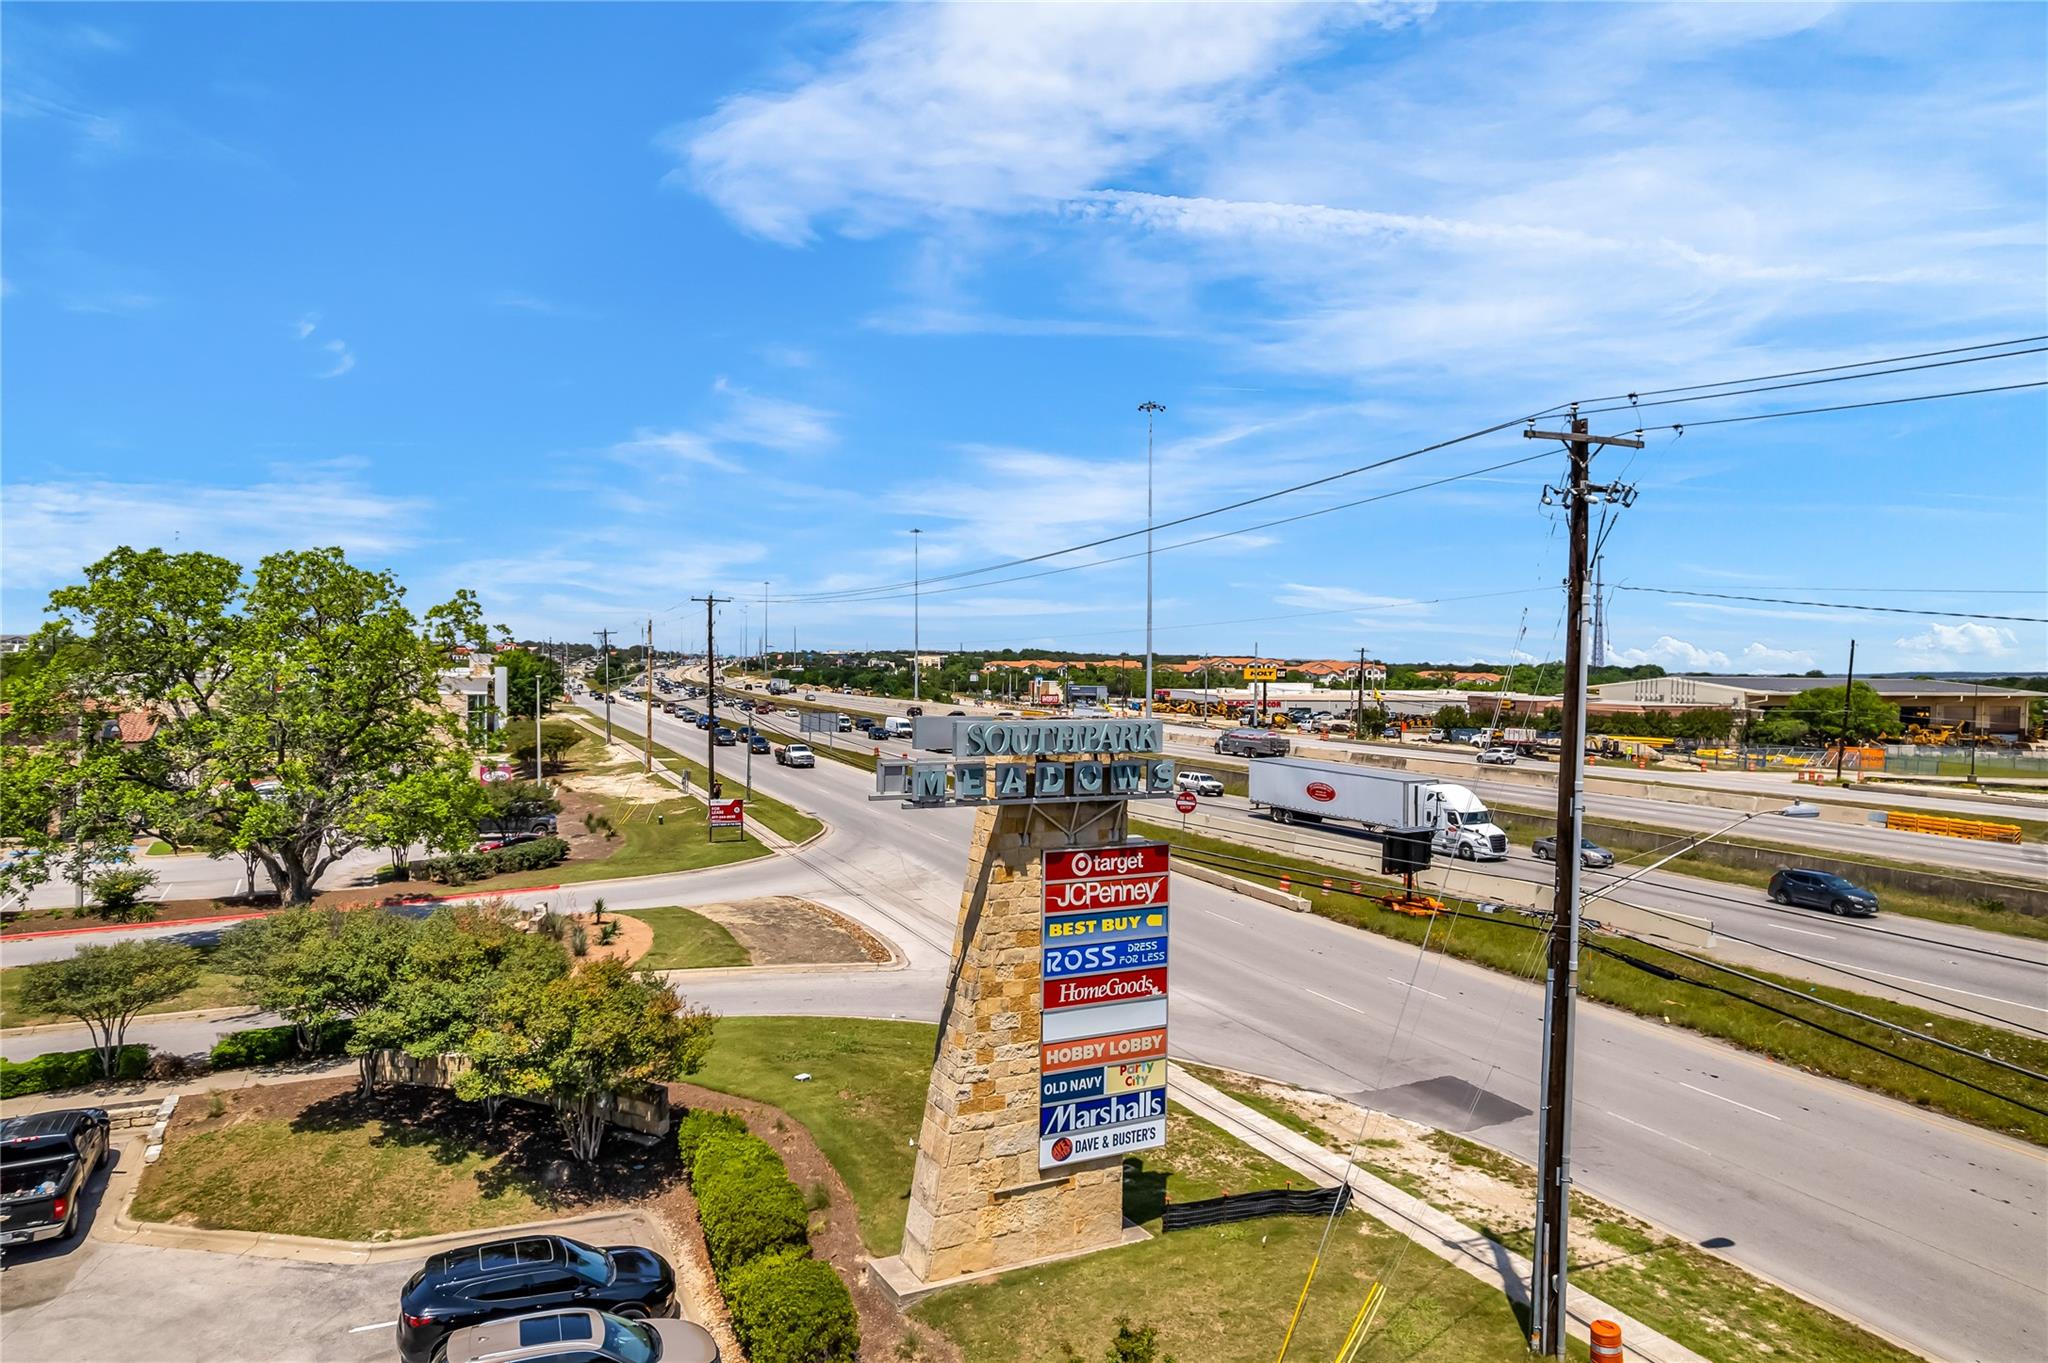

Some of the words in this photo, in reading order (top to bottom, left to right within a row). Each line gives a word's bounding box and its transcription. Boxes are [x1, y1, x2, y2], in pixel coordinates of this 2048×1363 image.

[966, 721, 1161, 755] SOUTHPARK
[918, 759, 1174, 797] MEADOWS
[1094, 852, 1144, 873] target
[1047, 876, 1166, 908] JCPenney
[1049, 921, 1097, 937] BEST
[1101, 915, 1142, 932] BUY
[1046, 945, 1116, 973] ROSS
[1119, 955, 1139, 965] FOR
[1141, 951, 1165, 963] LESS
[1127, 941, 1158, 953] DRESS
[1058, 975, 1154, 1003] HomeGoods
[1046, 1042, 1106, 1065] HOBBY
[1109, 1034, 1163, 1056] LOBBY
[1044, 1081, 1068, 1096] OLD
[1070, 1075, 1103, 1092] NAVY
[1125, 1075, 1149, 1087] City
[1044, 1090, 1162, 1135] Marshalls
[1075, 1137, 1099, 1154] DAVE
[1102, 1135, 1110, 1149] &
[1112, 1127, 1156, 1147] BUSTER'S
